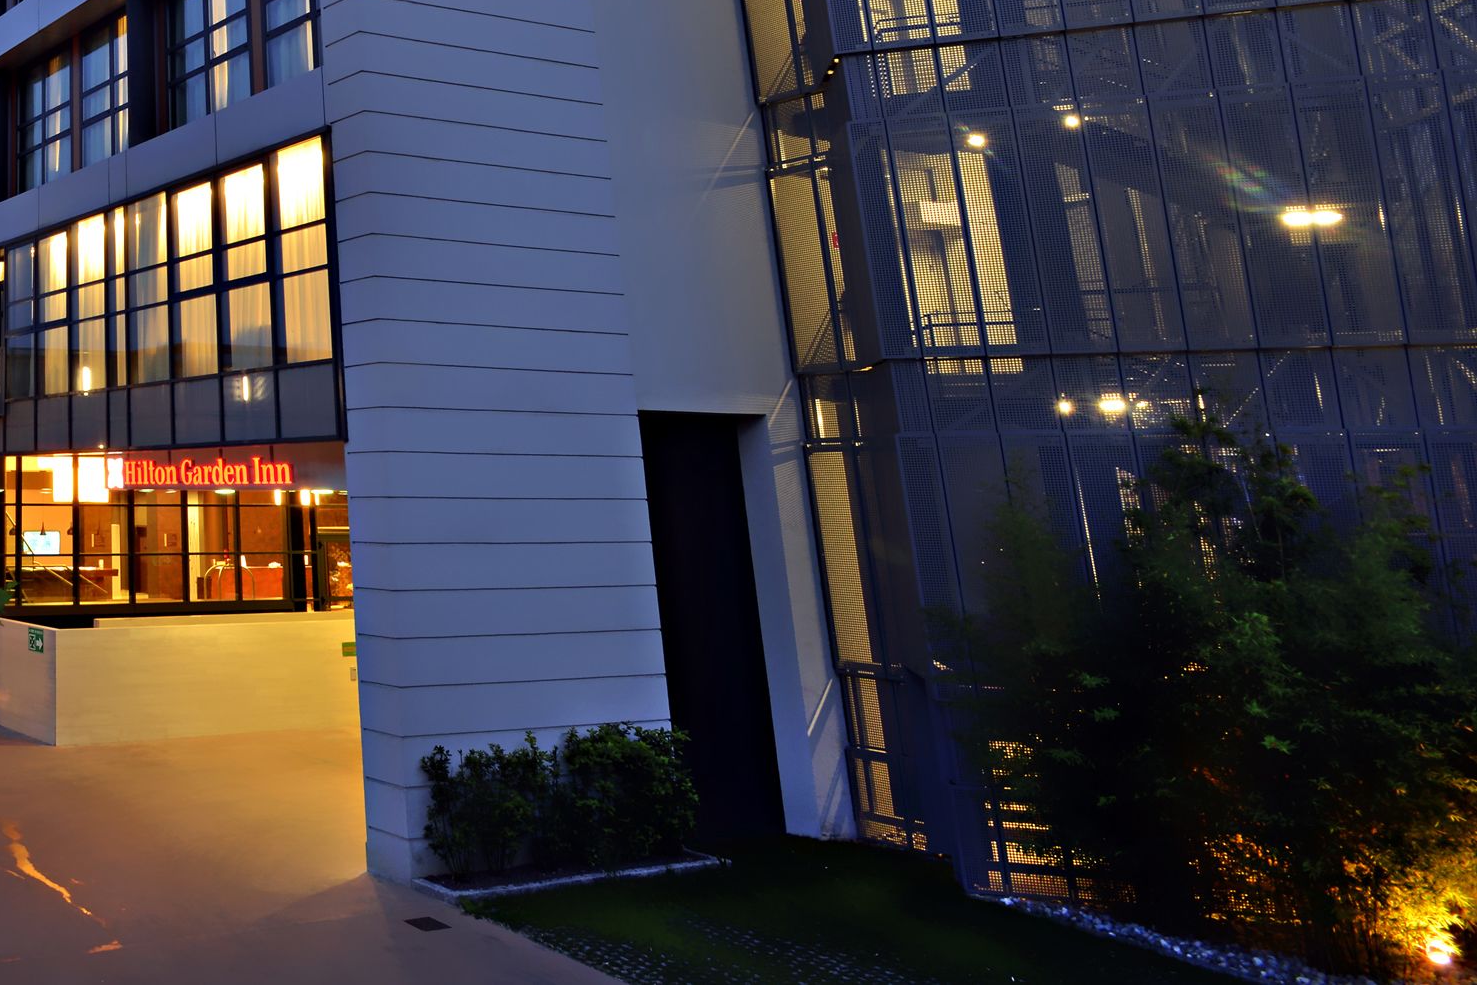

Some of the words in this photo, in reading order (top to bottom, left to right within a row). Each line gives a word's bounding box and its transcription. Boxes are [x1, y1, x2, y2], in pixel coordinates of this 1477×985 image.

[124, 461, 177, 485] Hilton
[180, 458, 249, 486] Garden
[252, 457, 292, 485] Inn
